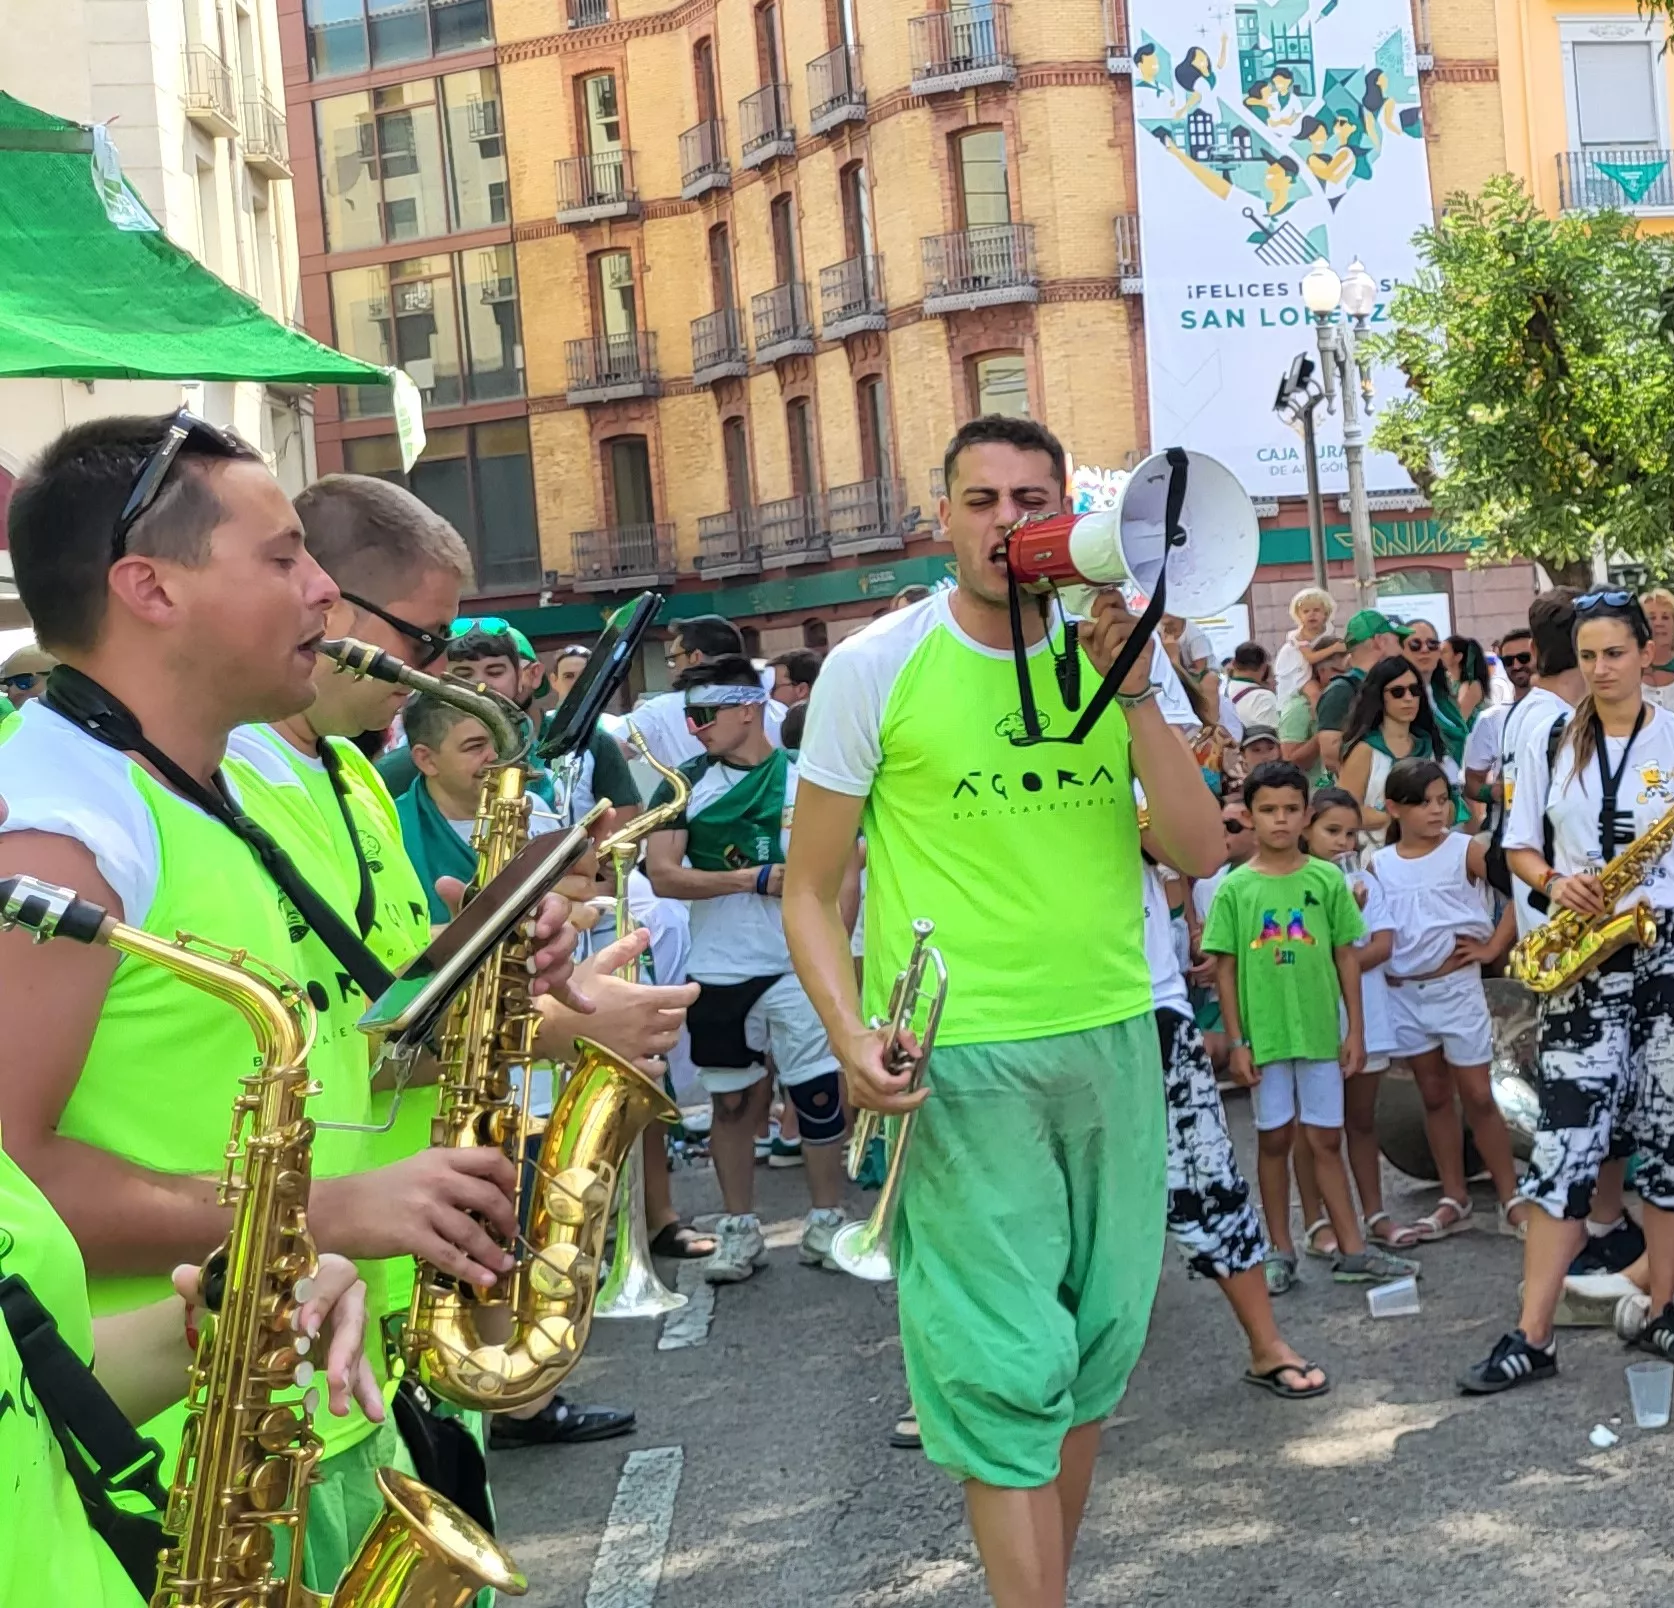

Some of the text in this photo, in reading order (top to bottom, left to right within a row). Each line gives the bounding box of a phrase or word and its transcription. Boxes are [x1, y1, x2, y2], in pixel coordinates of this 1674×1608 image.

[1187, 282, 1289, 299] ¡FELICES
[1180, 303, 1388, 330] SAN LOREZ
[1256, 446, 1300, 462] CAJA
[1270, 464, 1288, 476] DE
